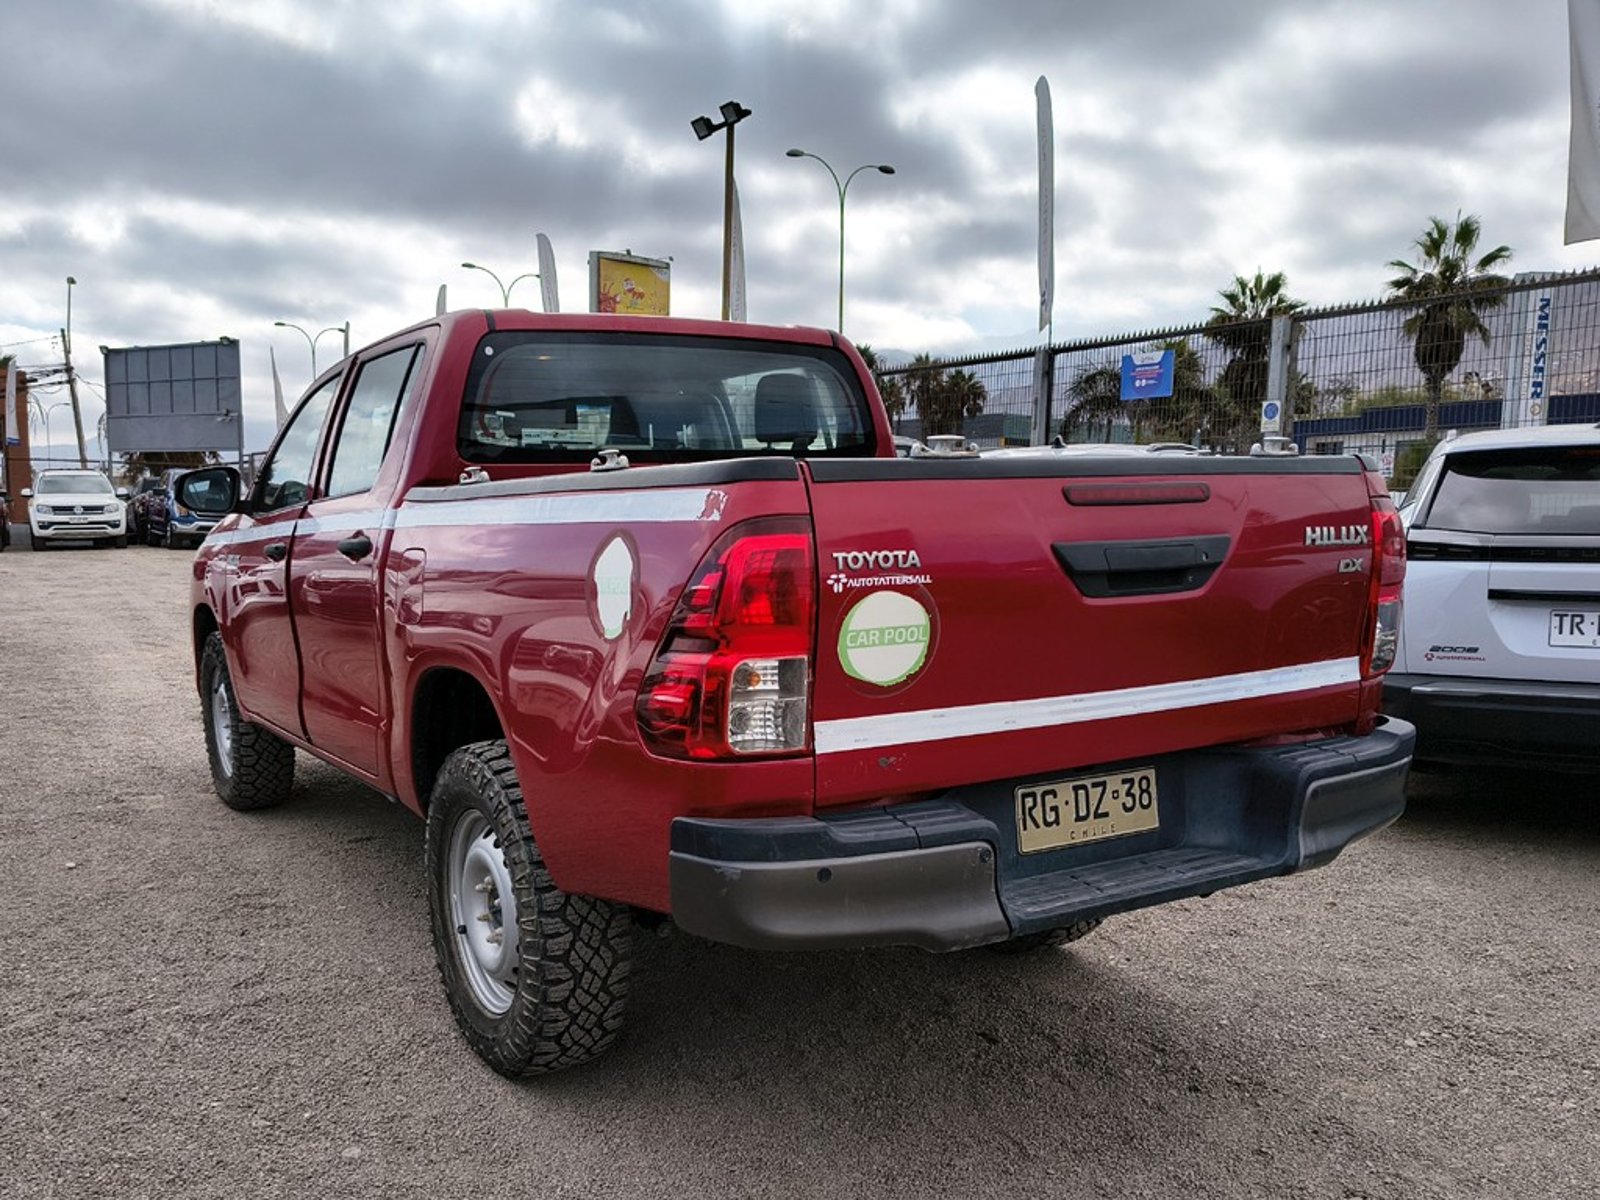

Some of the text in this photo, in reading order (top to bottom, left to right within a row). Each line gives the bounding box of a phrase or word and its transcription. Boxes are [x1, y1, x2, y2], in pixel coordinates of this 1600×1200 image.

[1530, 298, 1551, 399] MESSER
[1305, 525, 1368, 546] HILUX
[832, 550, 921, 570] TOYOTA
[1339, 558, 1364, 573] DX
[847, 574, 932, 588] AUTOTATTERSALL
[846, 626, 928, 648] CAR POOL
[1070, 823, 1117, 840] CHILE
